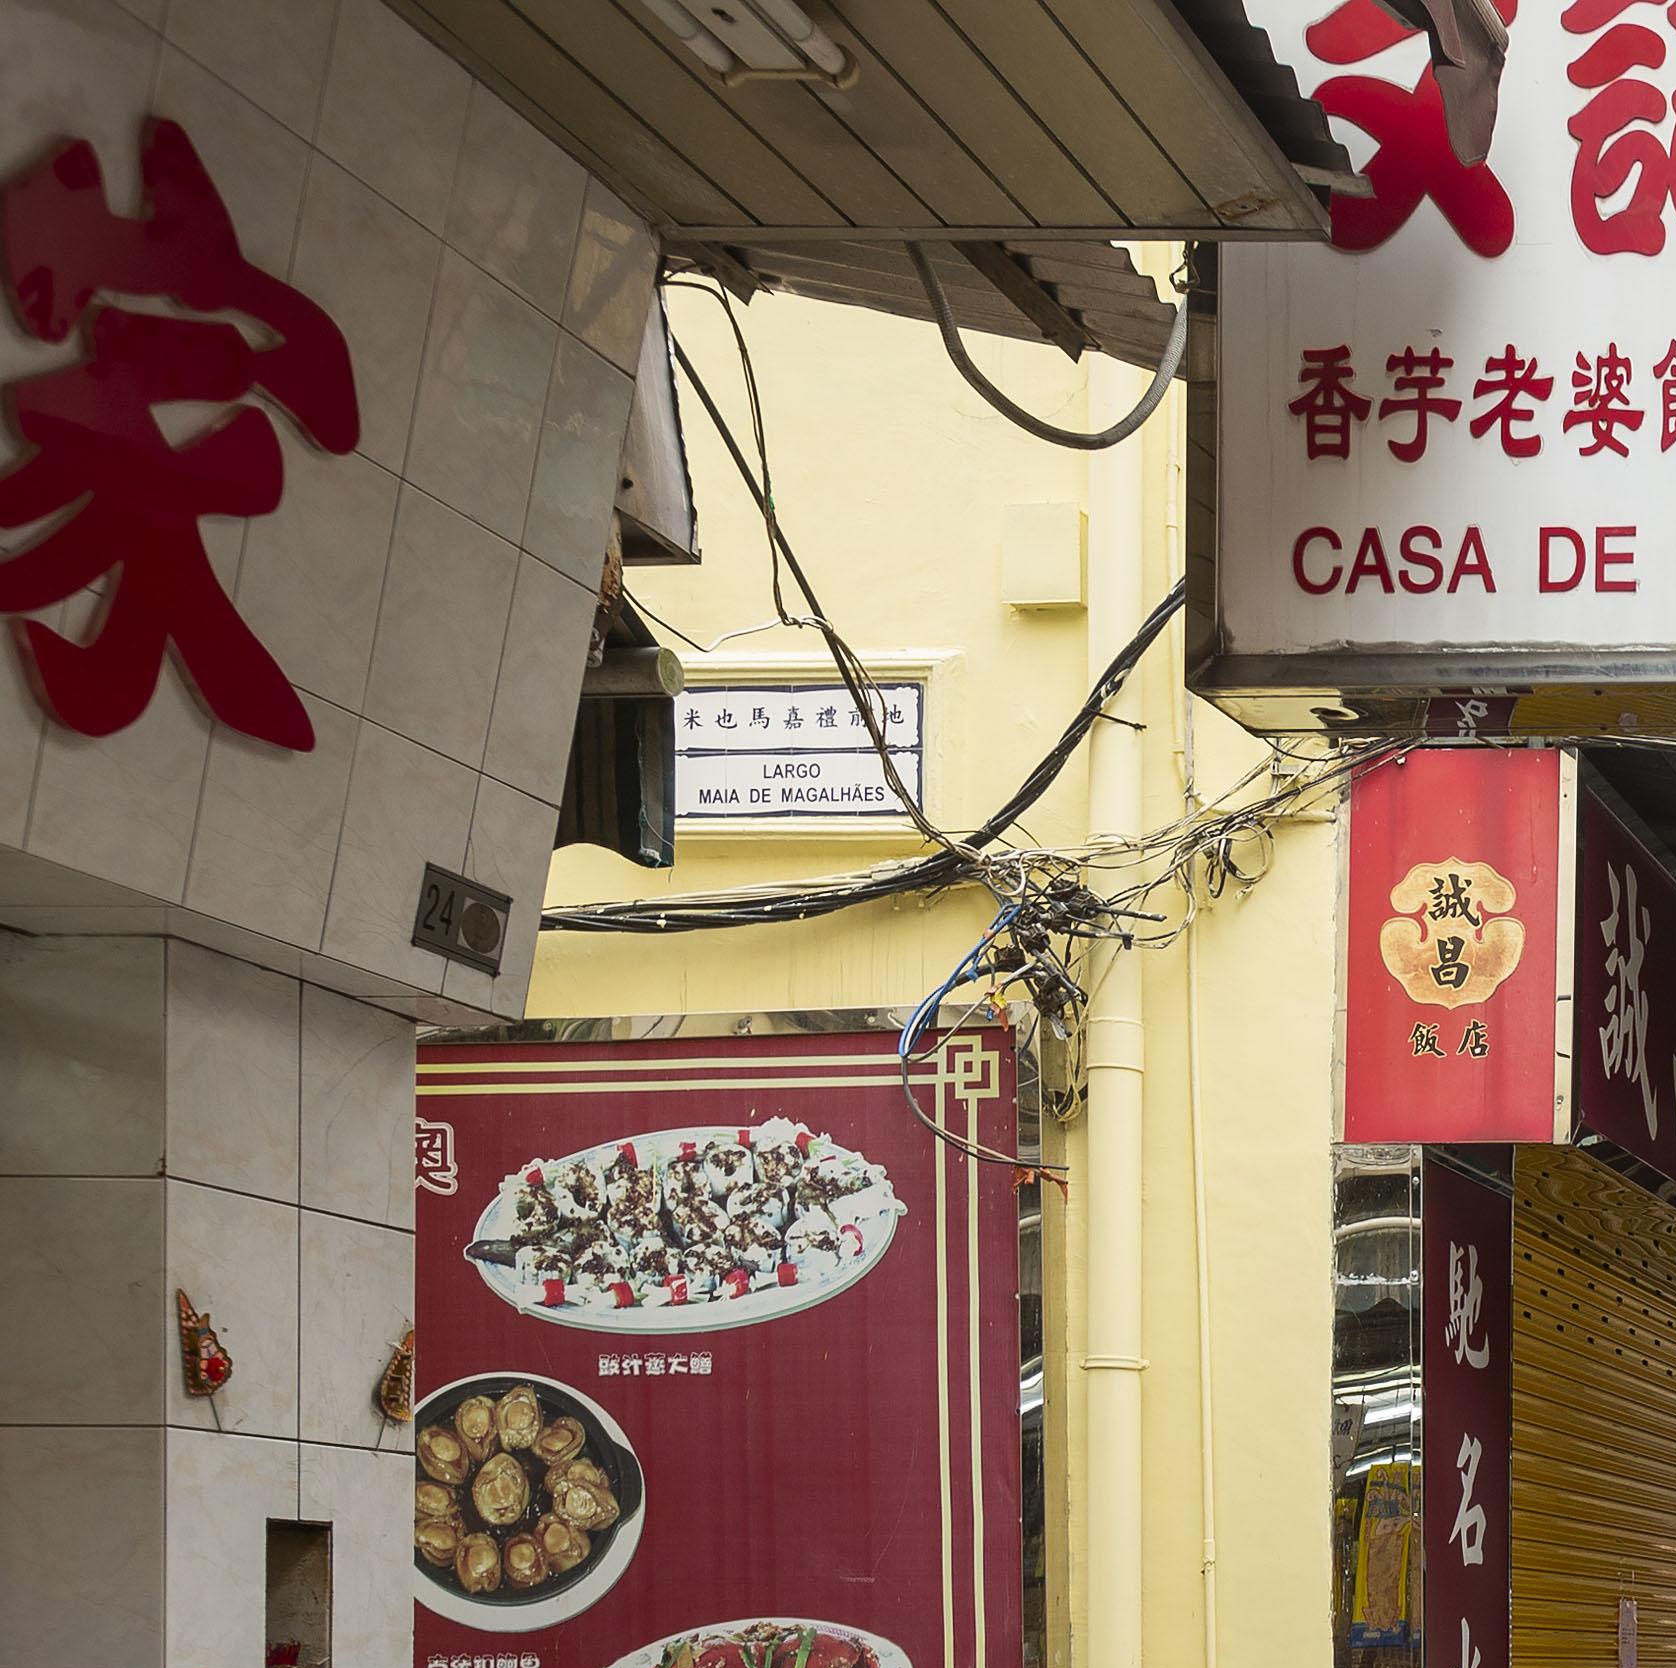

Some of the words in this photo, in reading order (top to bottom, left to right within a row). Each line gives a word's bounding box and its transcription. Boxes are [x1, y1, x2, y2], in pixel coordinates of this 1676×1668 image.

[1292, 525, 1496, 594] CASA
[1539, 524, 1638, 593] DE
[763, 764, 820, 779] LARGO
[699, 788, 740, 804] MAIA
[750, 788, 771, 803] DE
[781, 784, 884, 802] MAGALHÃES
[1428, 873, 1481, 989] 誠昌
[1409, 1019, 1490, 1059] 飯店
